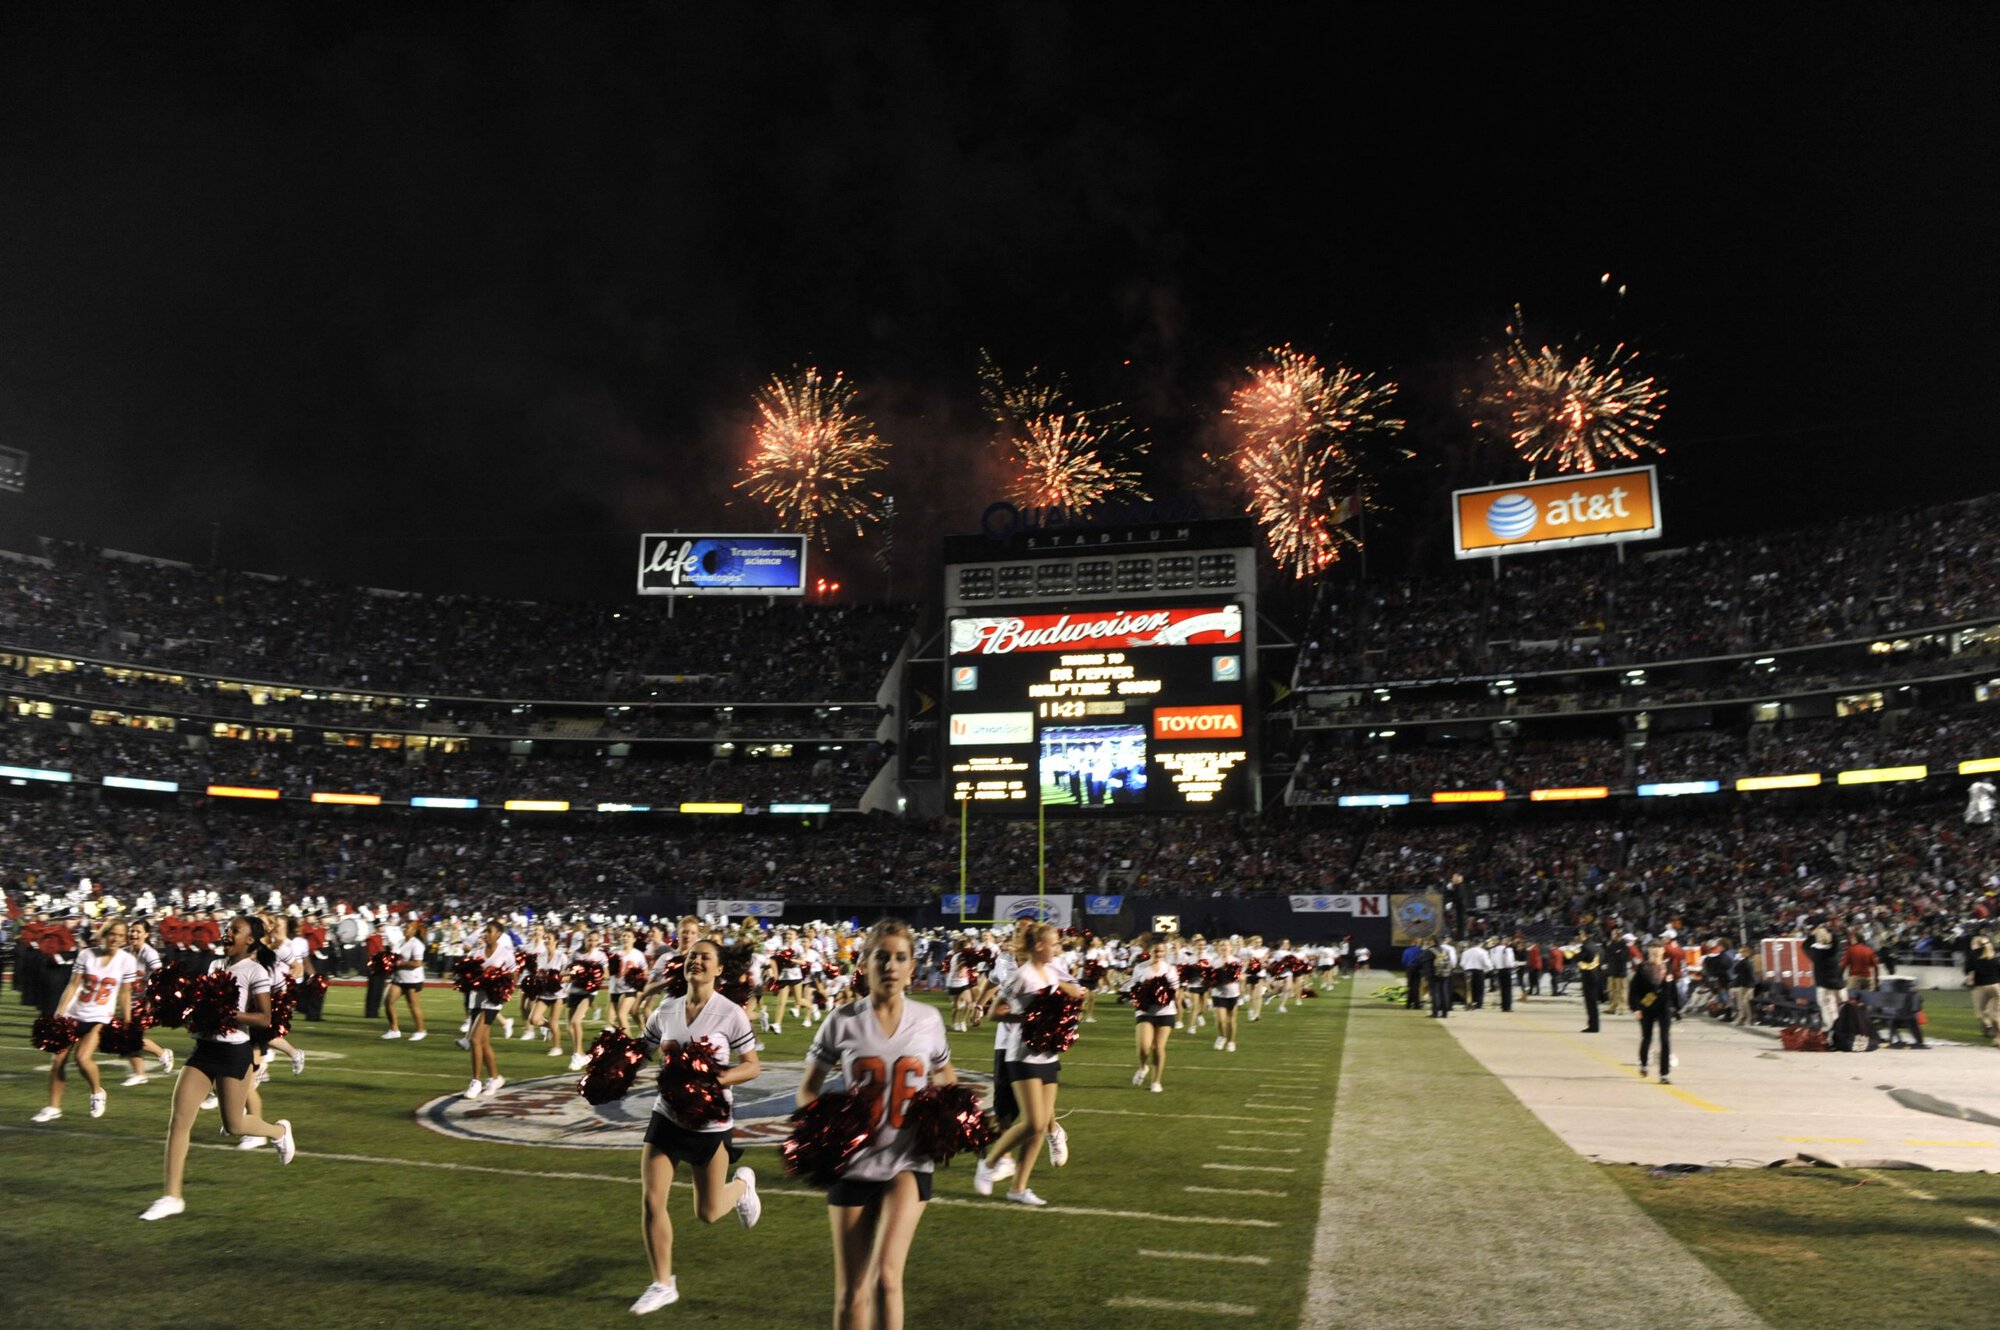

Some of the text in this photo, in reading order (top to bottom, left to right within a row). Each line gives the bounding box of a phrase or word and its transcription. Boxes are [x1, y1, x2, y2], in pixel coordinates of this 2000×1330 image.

[1545, 486, 1630, 526] at&t
[644, 540, 698, 585] life
[730, 547, 797, 558] Transforming
[744, 557, 782, 565] science
[977, 610, 1169, 655] Budweiser
[1157, 714, 1239, 732] TOYOTA
[1359, 896, 1380, 916] N
